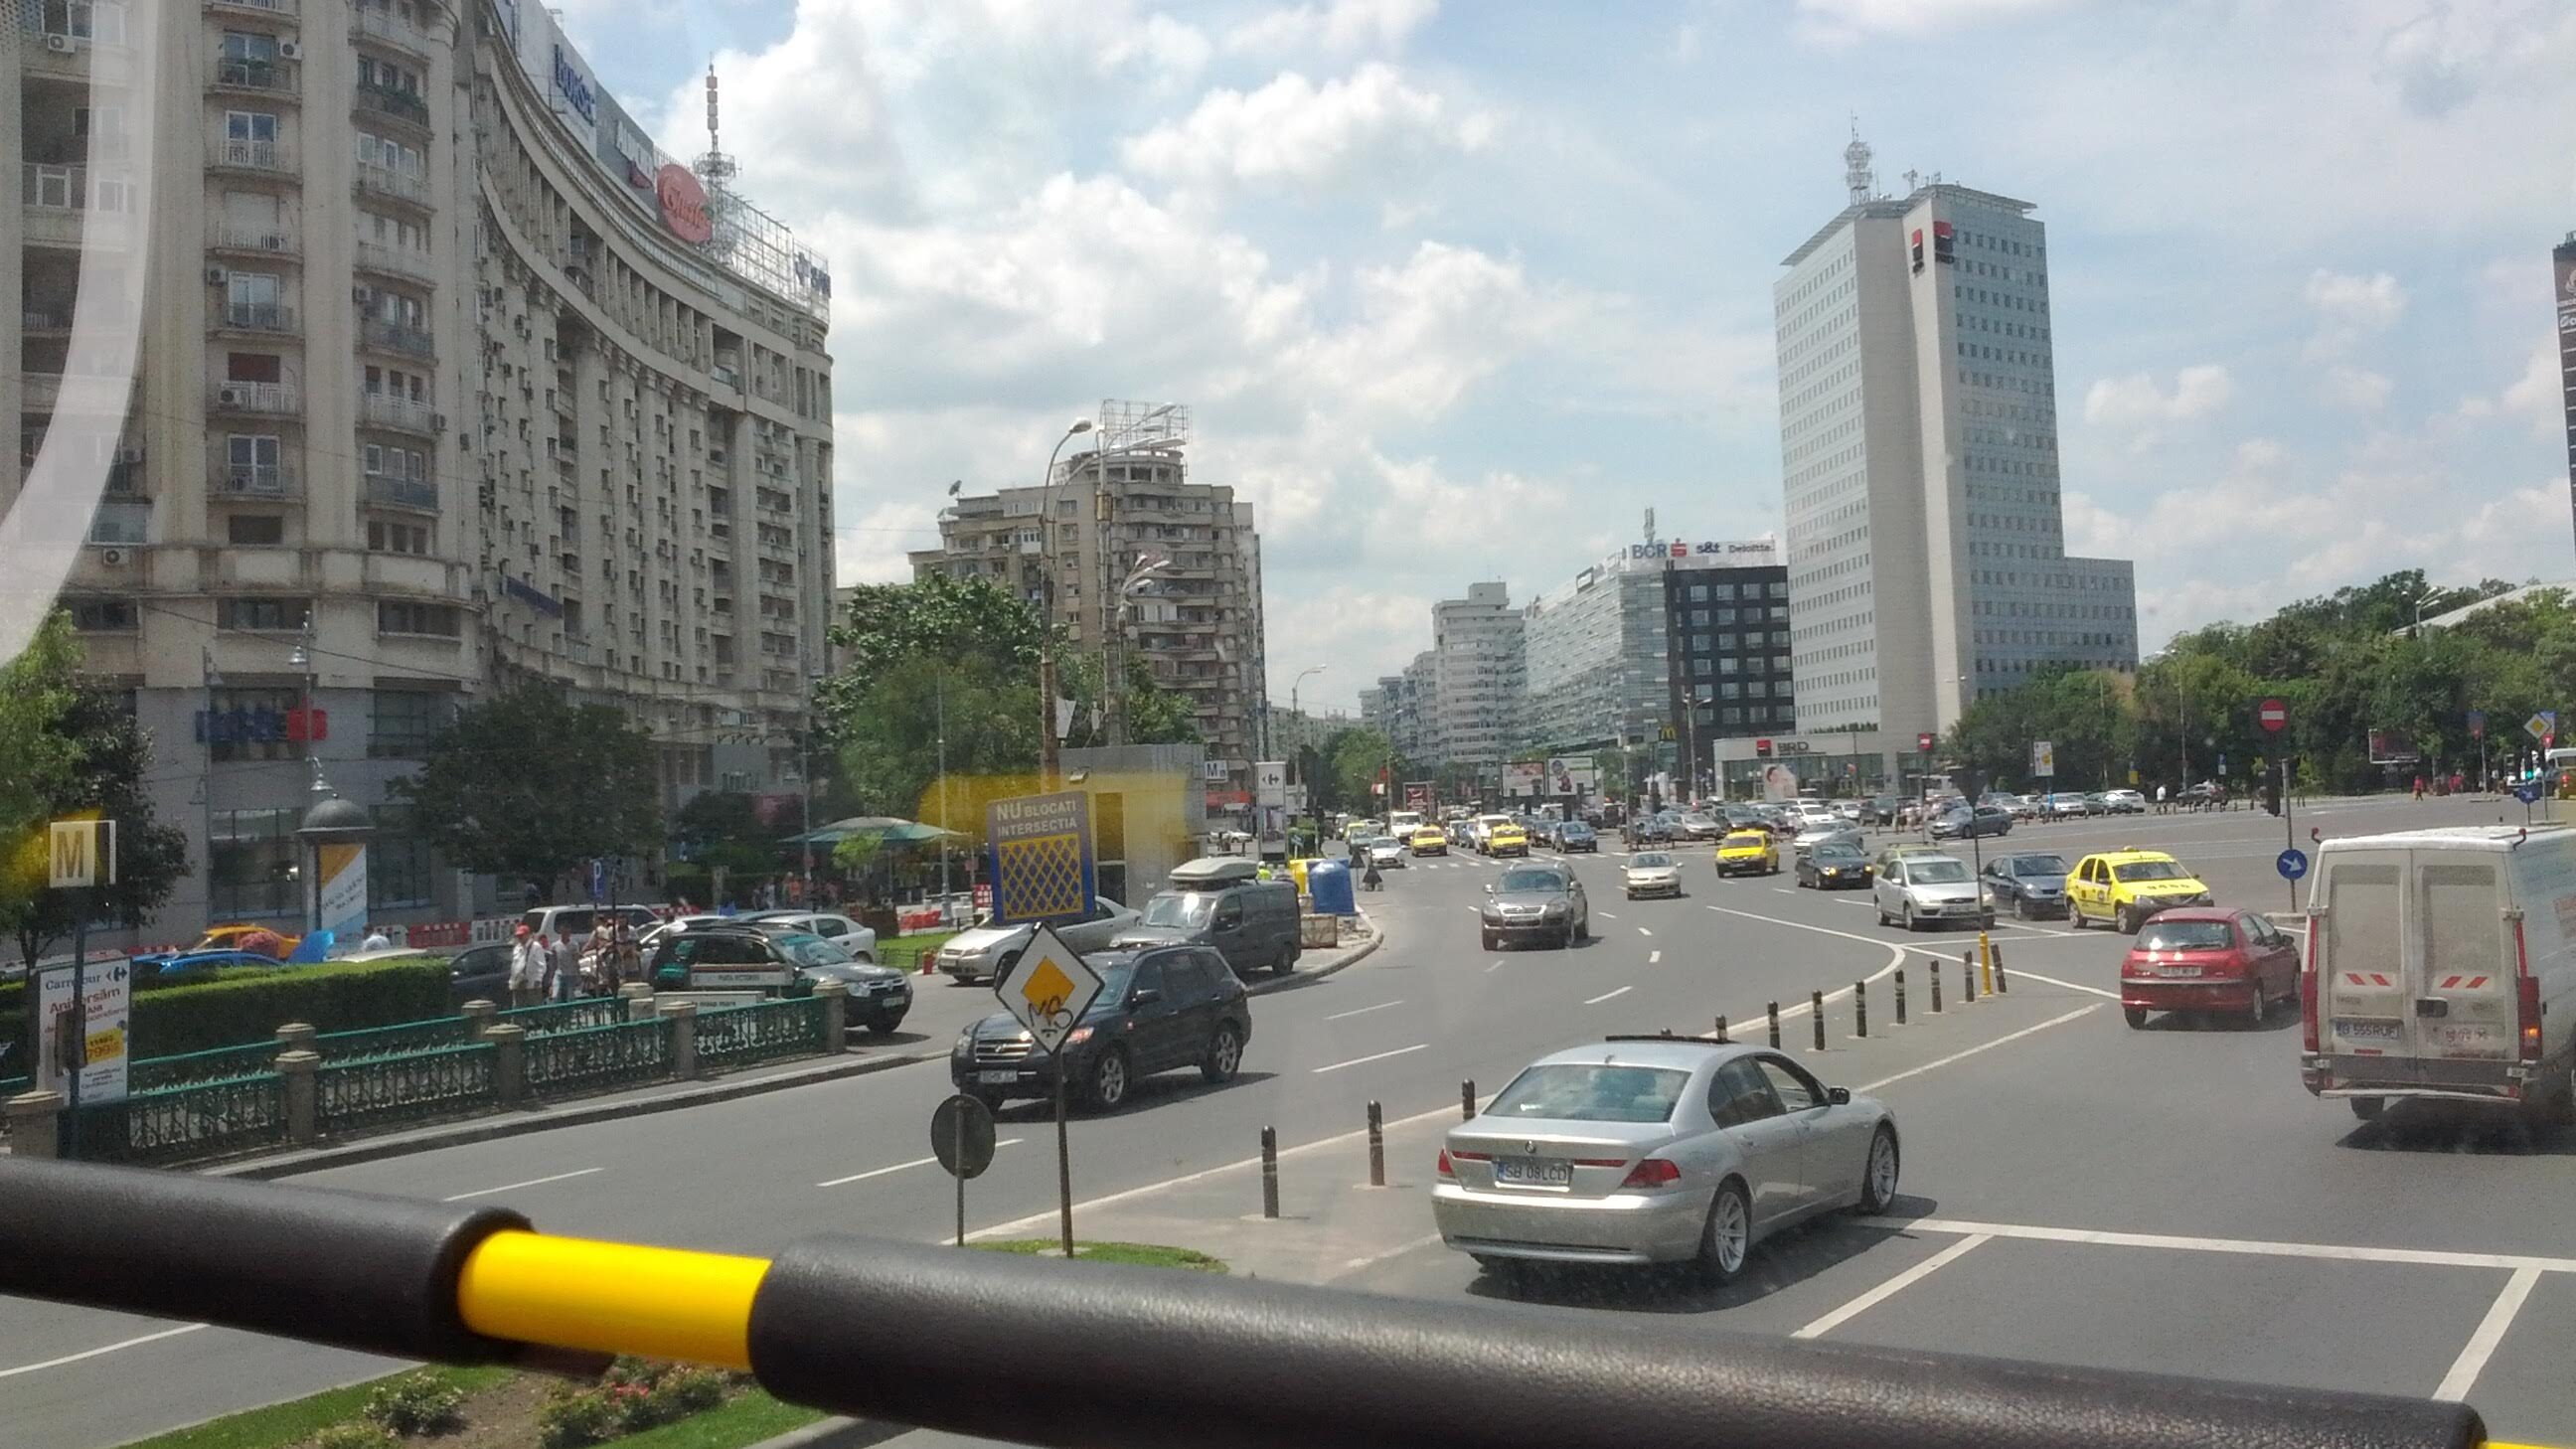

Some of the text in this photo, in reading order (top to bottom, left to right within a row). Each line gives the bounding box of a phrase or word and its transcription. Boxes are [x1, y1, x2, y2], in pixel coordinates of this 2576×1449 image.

[1631, 544, 1668, 559] BCR
[1777, 741, 1810, 752] BRD
[997, 800, 1076, 822] NU BLOCATI
[997, 817, 1077, 838] INTERSECTIA
[56, 829, 84, 879] M
